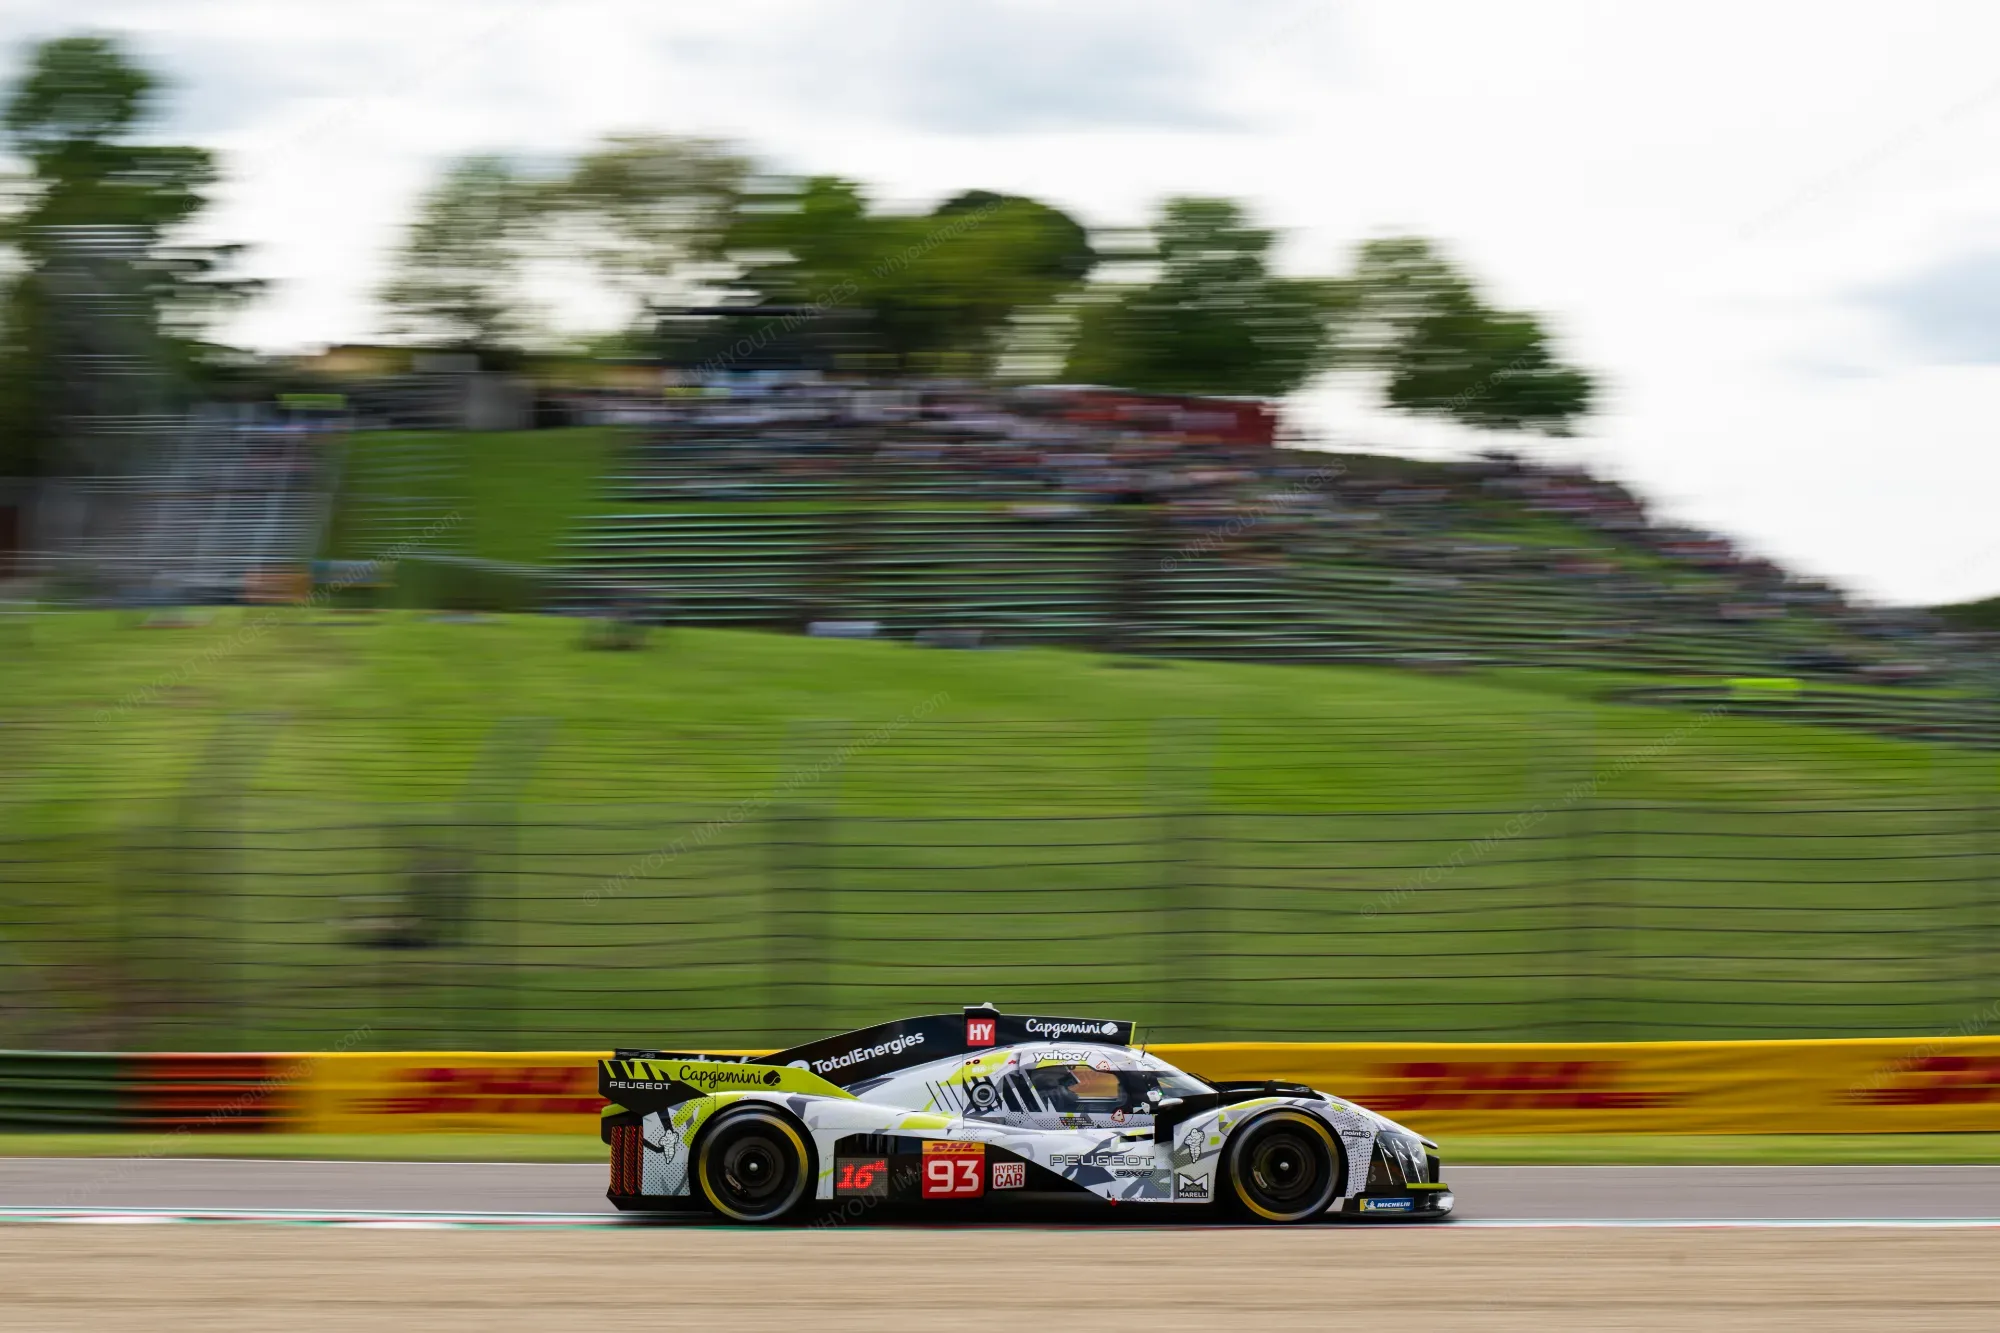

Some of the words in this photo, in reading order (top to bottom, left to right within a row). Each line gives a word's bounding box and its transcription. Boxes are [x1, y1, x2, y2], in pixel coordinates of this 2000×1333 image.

[969, 1023, 993, 1041] HY
[1025, 1018, 1101, 1039] Capgemini
[812, 1032, 925, 1075] TotalEnergies
[1033, 1050, 1091, 1063] yahoo!
[679, 1065, 761, 1089] Capgemini
[609, 1081, 671, 1090] PEUGEOT
[931, 1142, 976, 1153] DHL
[1050, 1154, 1155, 1166] PEUGEOT
[995, 1164, 1023, 1174] HYPER
[928, 1160, 979, 1193] 93
[995, 1173, 1023, 1187] CAR
